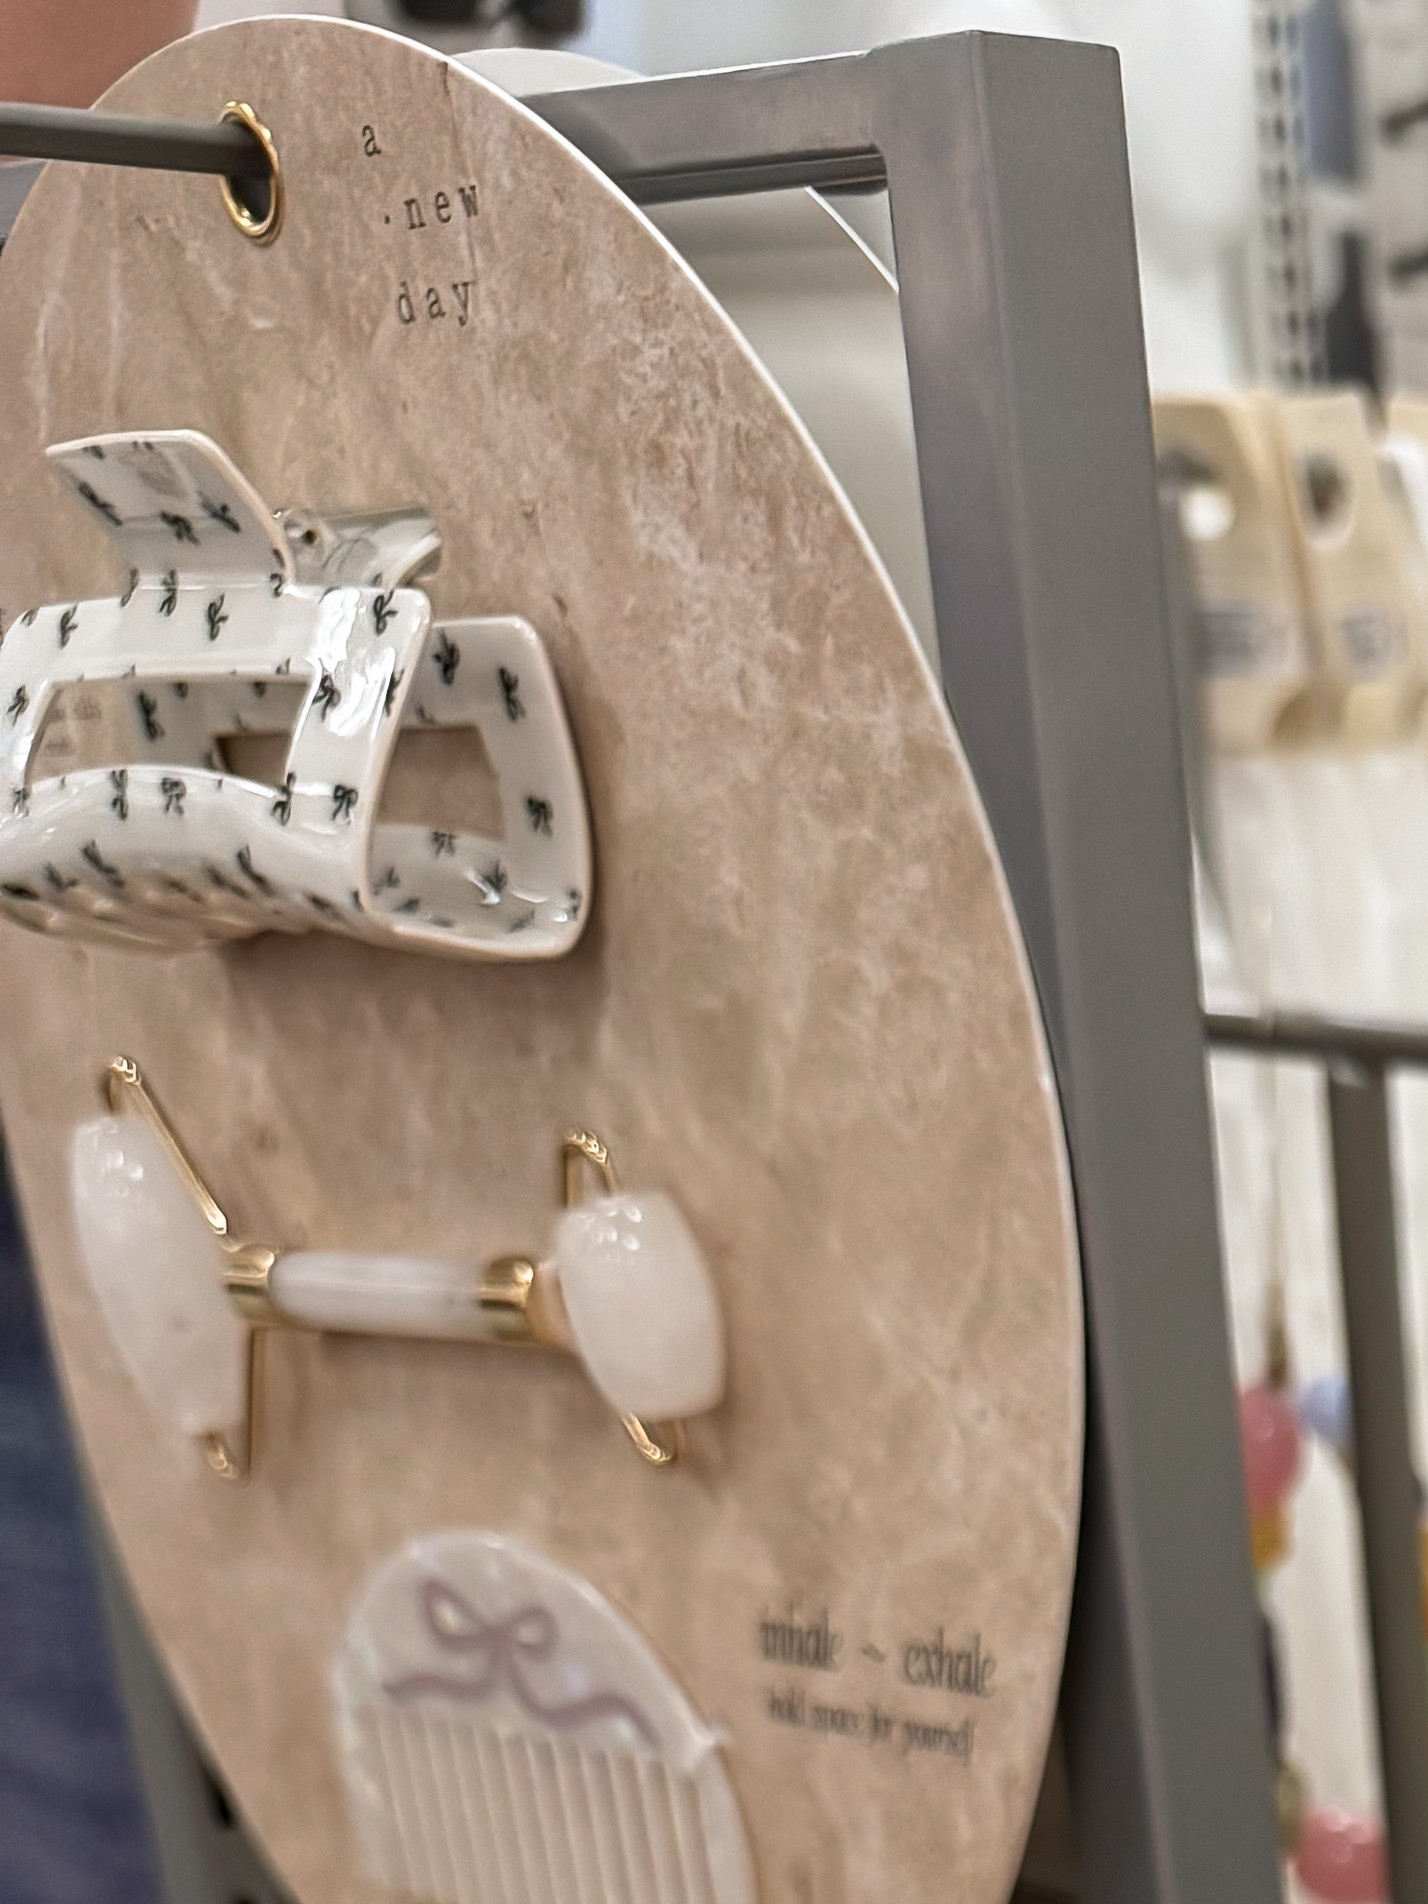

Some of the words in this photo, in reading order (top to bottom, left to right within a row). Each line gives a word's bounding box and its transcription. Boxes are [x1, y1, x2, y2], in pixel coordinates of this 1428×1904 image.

[361, 124, 381, 157] a
[397, 279, 477, 328] day
[902, 1627, 997, 1698] exhale
